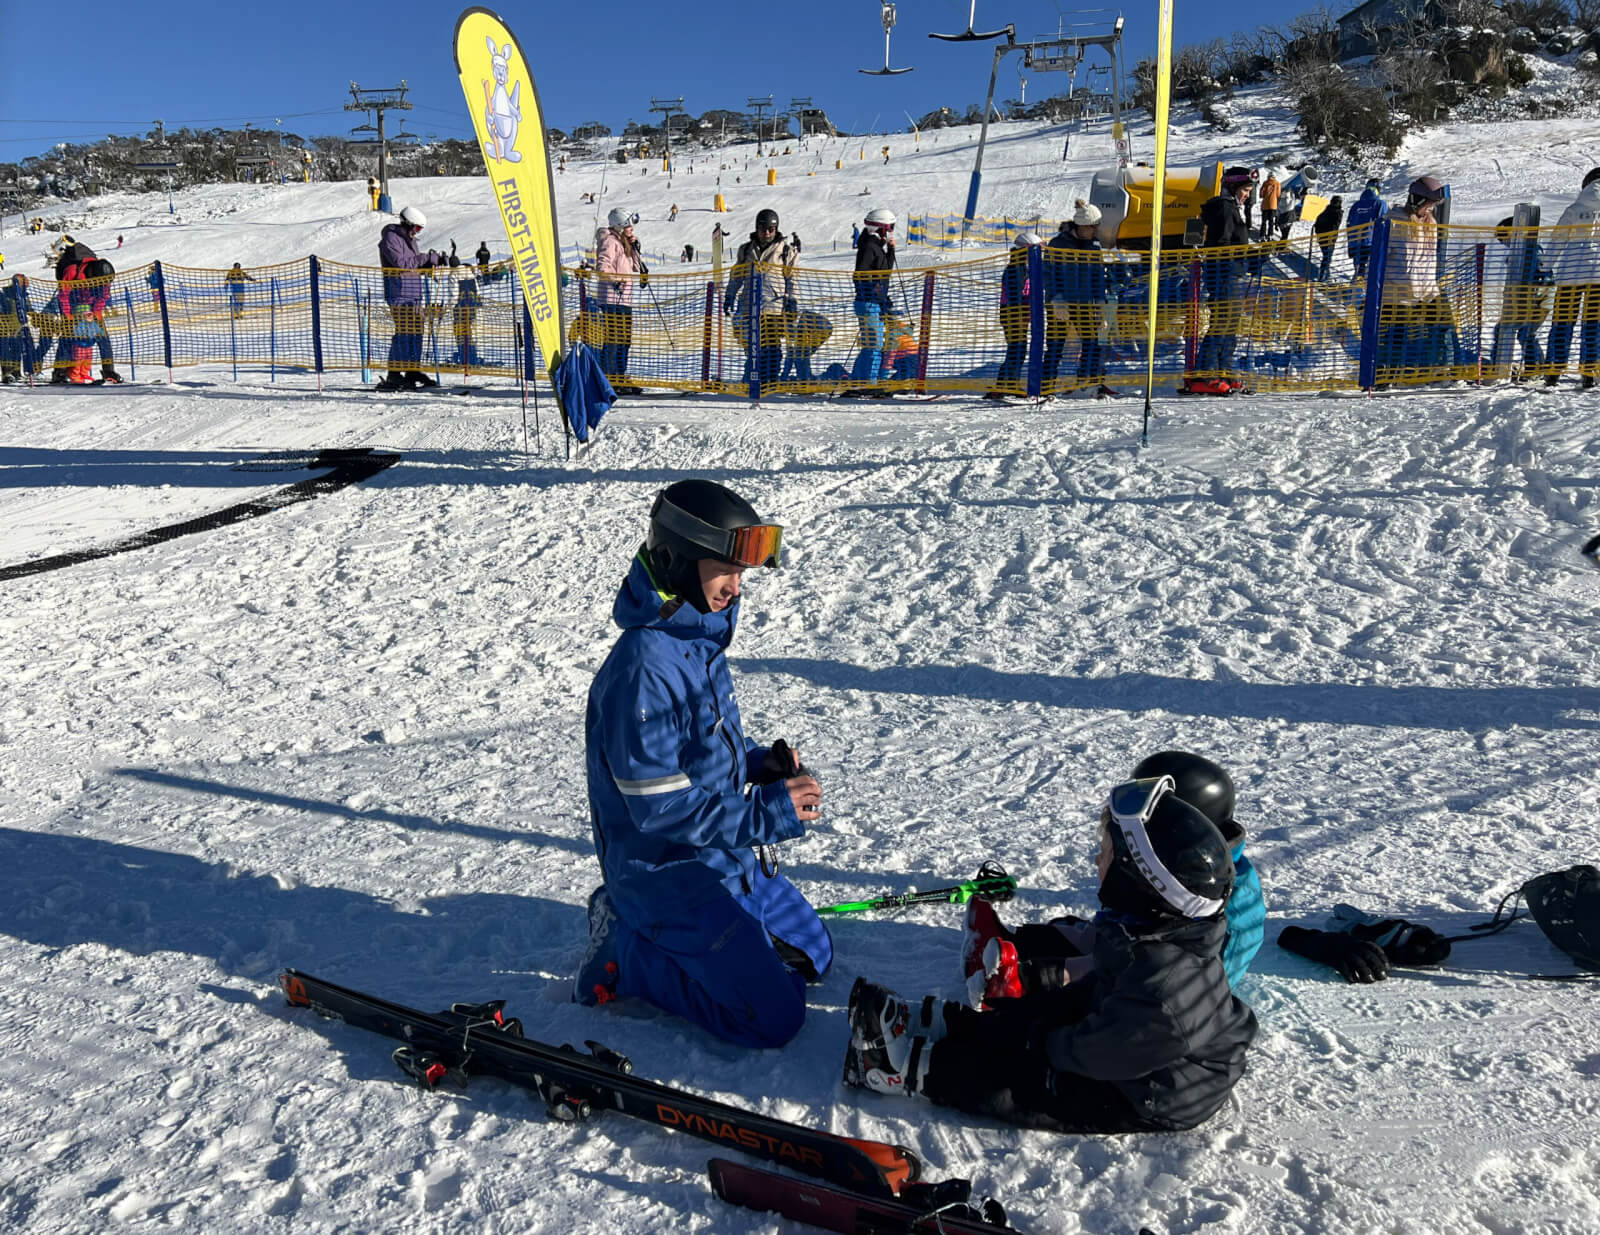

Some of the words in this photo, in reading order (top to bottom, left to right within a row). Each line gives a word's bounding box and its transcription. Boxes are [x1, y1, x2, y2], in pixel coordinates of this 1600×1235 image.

[498, 177, 553, 322] FIRST-TIMERS
[1125, 831, 1166, 892] GIRO
[656, 1104, 824, 1168] DYNASTAR
